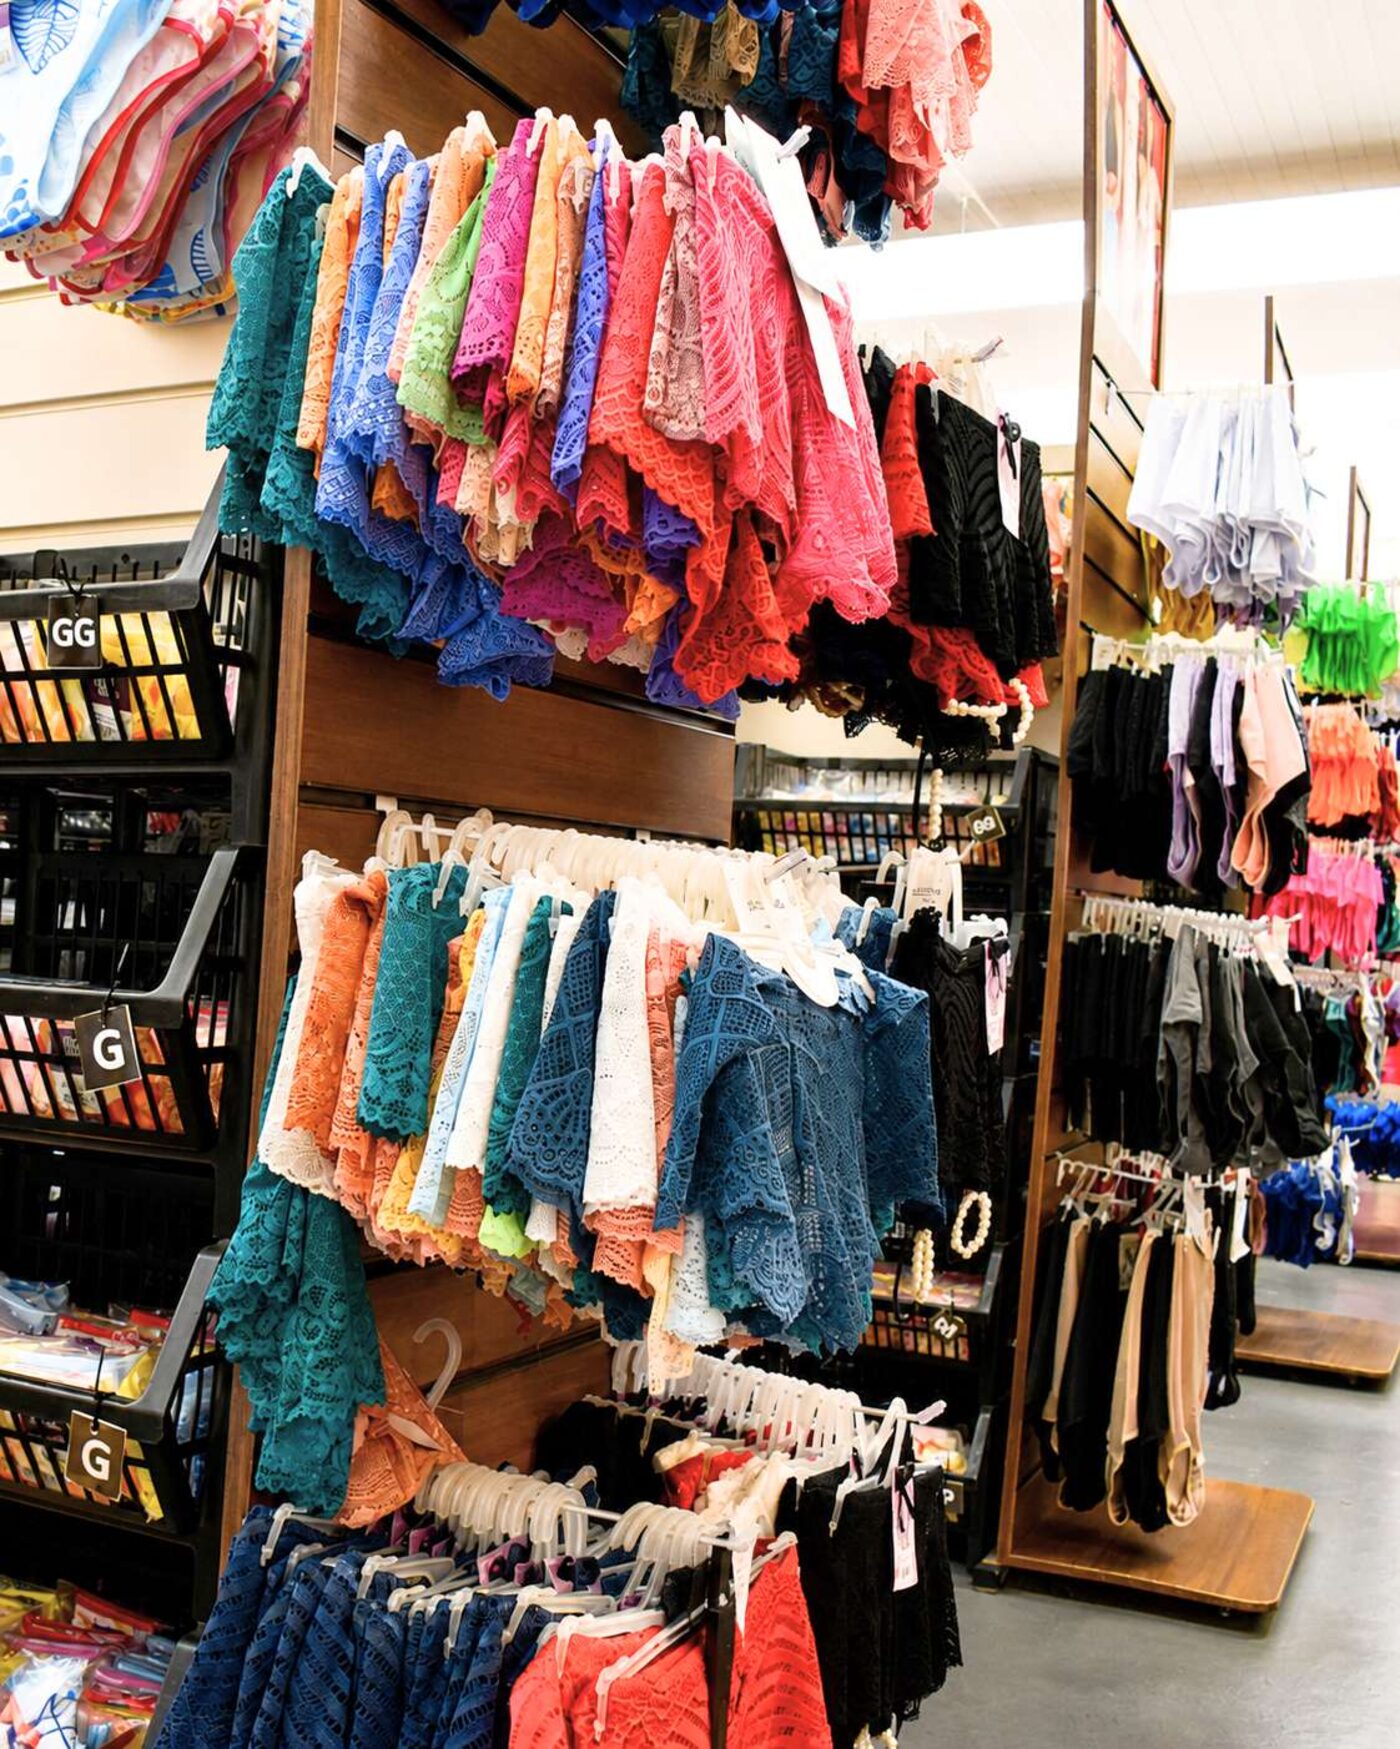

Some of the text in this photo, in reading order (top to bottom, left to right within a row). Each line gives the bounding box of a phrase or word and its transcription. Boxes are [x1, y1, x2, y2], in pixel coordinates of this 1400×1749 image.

[52, 617, 96, 648] GG
[92, 1028, 126, 1070] G
[81, 1438, 111, 1481] G
